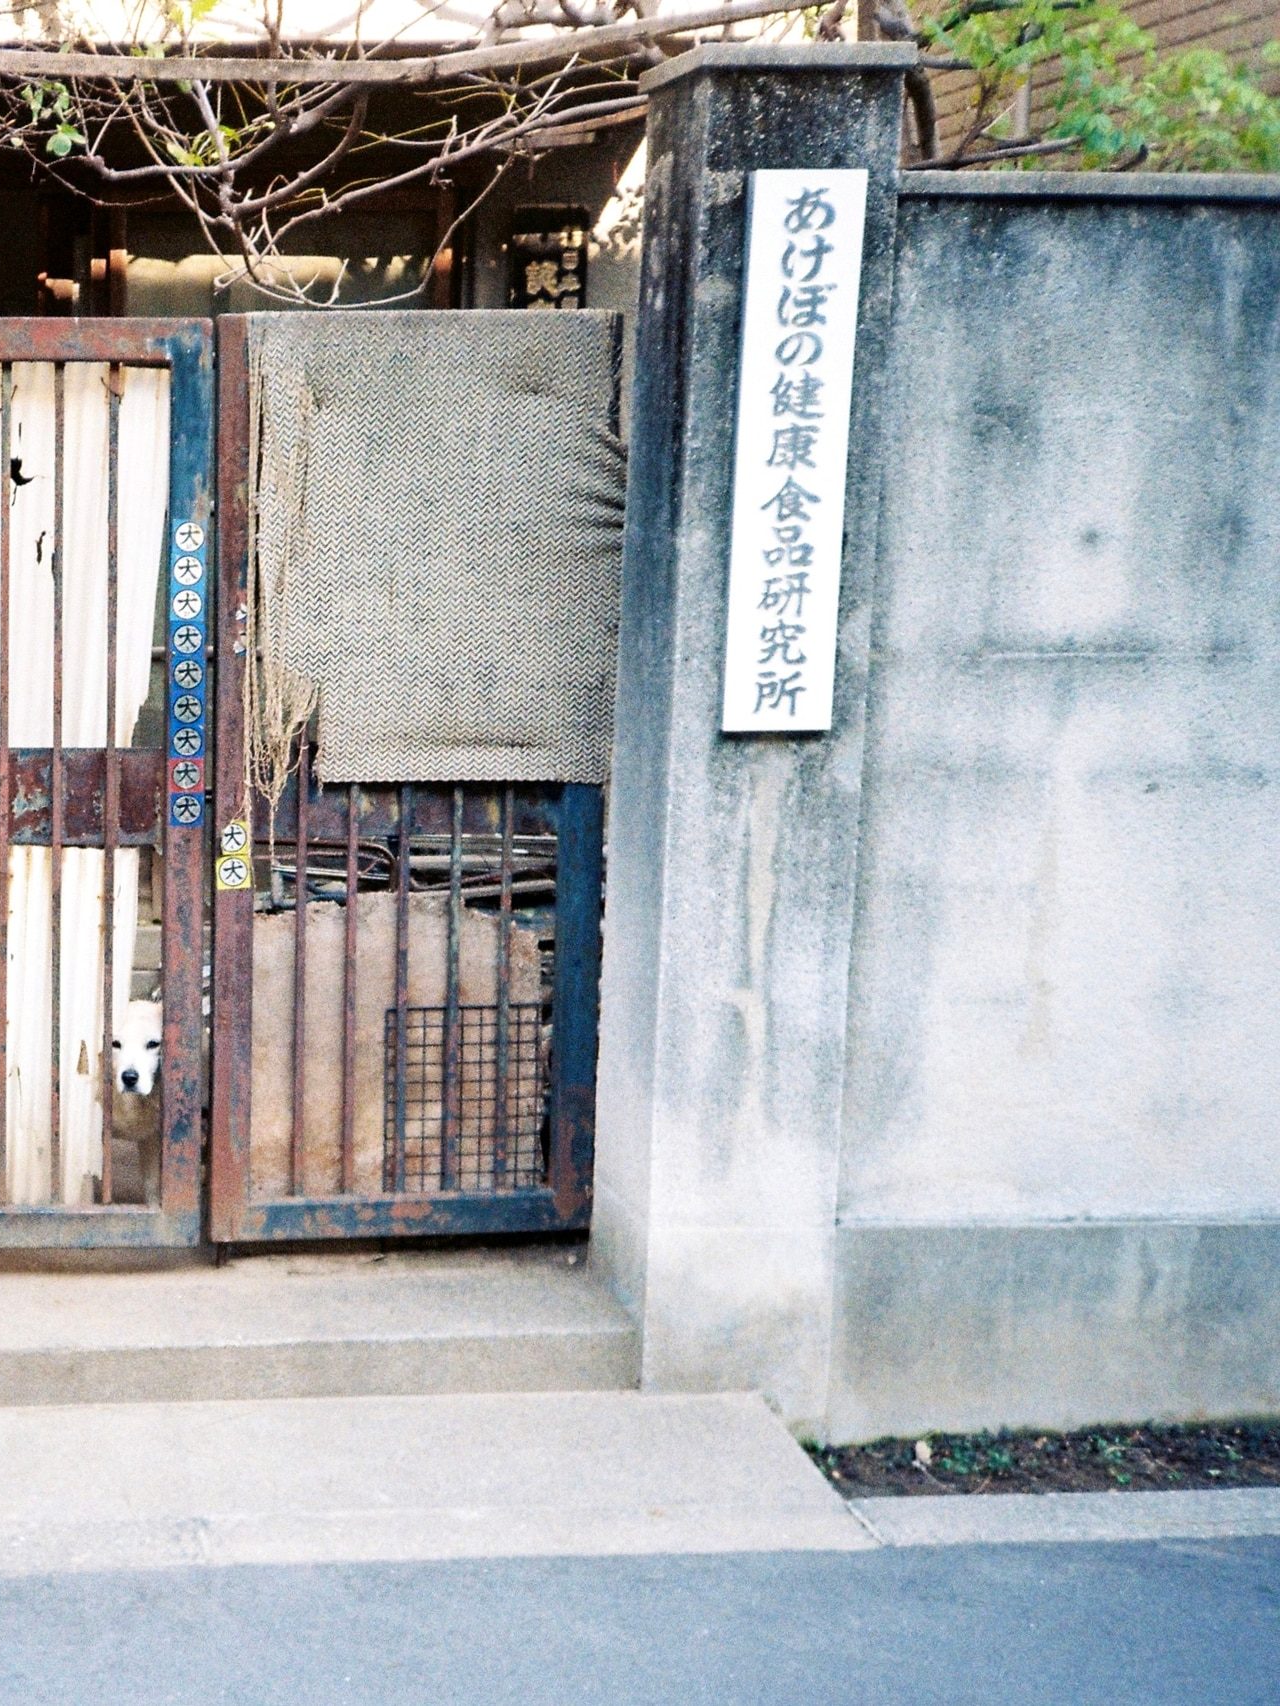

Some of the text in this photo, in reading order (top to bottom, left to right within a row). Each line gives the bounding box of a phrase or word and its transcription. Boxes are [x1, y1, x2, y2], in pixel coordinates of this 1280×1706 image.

[752, 186, 838, 717] あけぼの健康食品研究所
[177, 626, 199, 648] 犬
[178, 662, 199, 684] 犬
[177, 697, 198, 718] 犬
[176, 730, 198, 750] 犬
[176, 763, 197, 784] 犬
[176, 797, 197, 818] 犬
[224, 826, 242, 846] 犬
[223, 860, 243, 880] 犬
